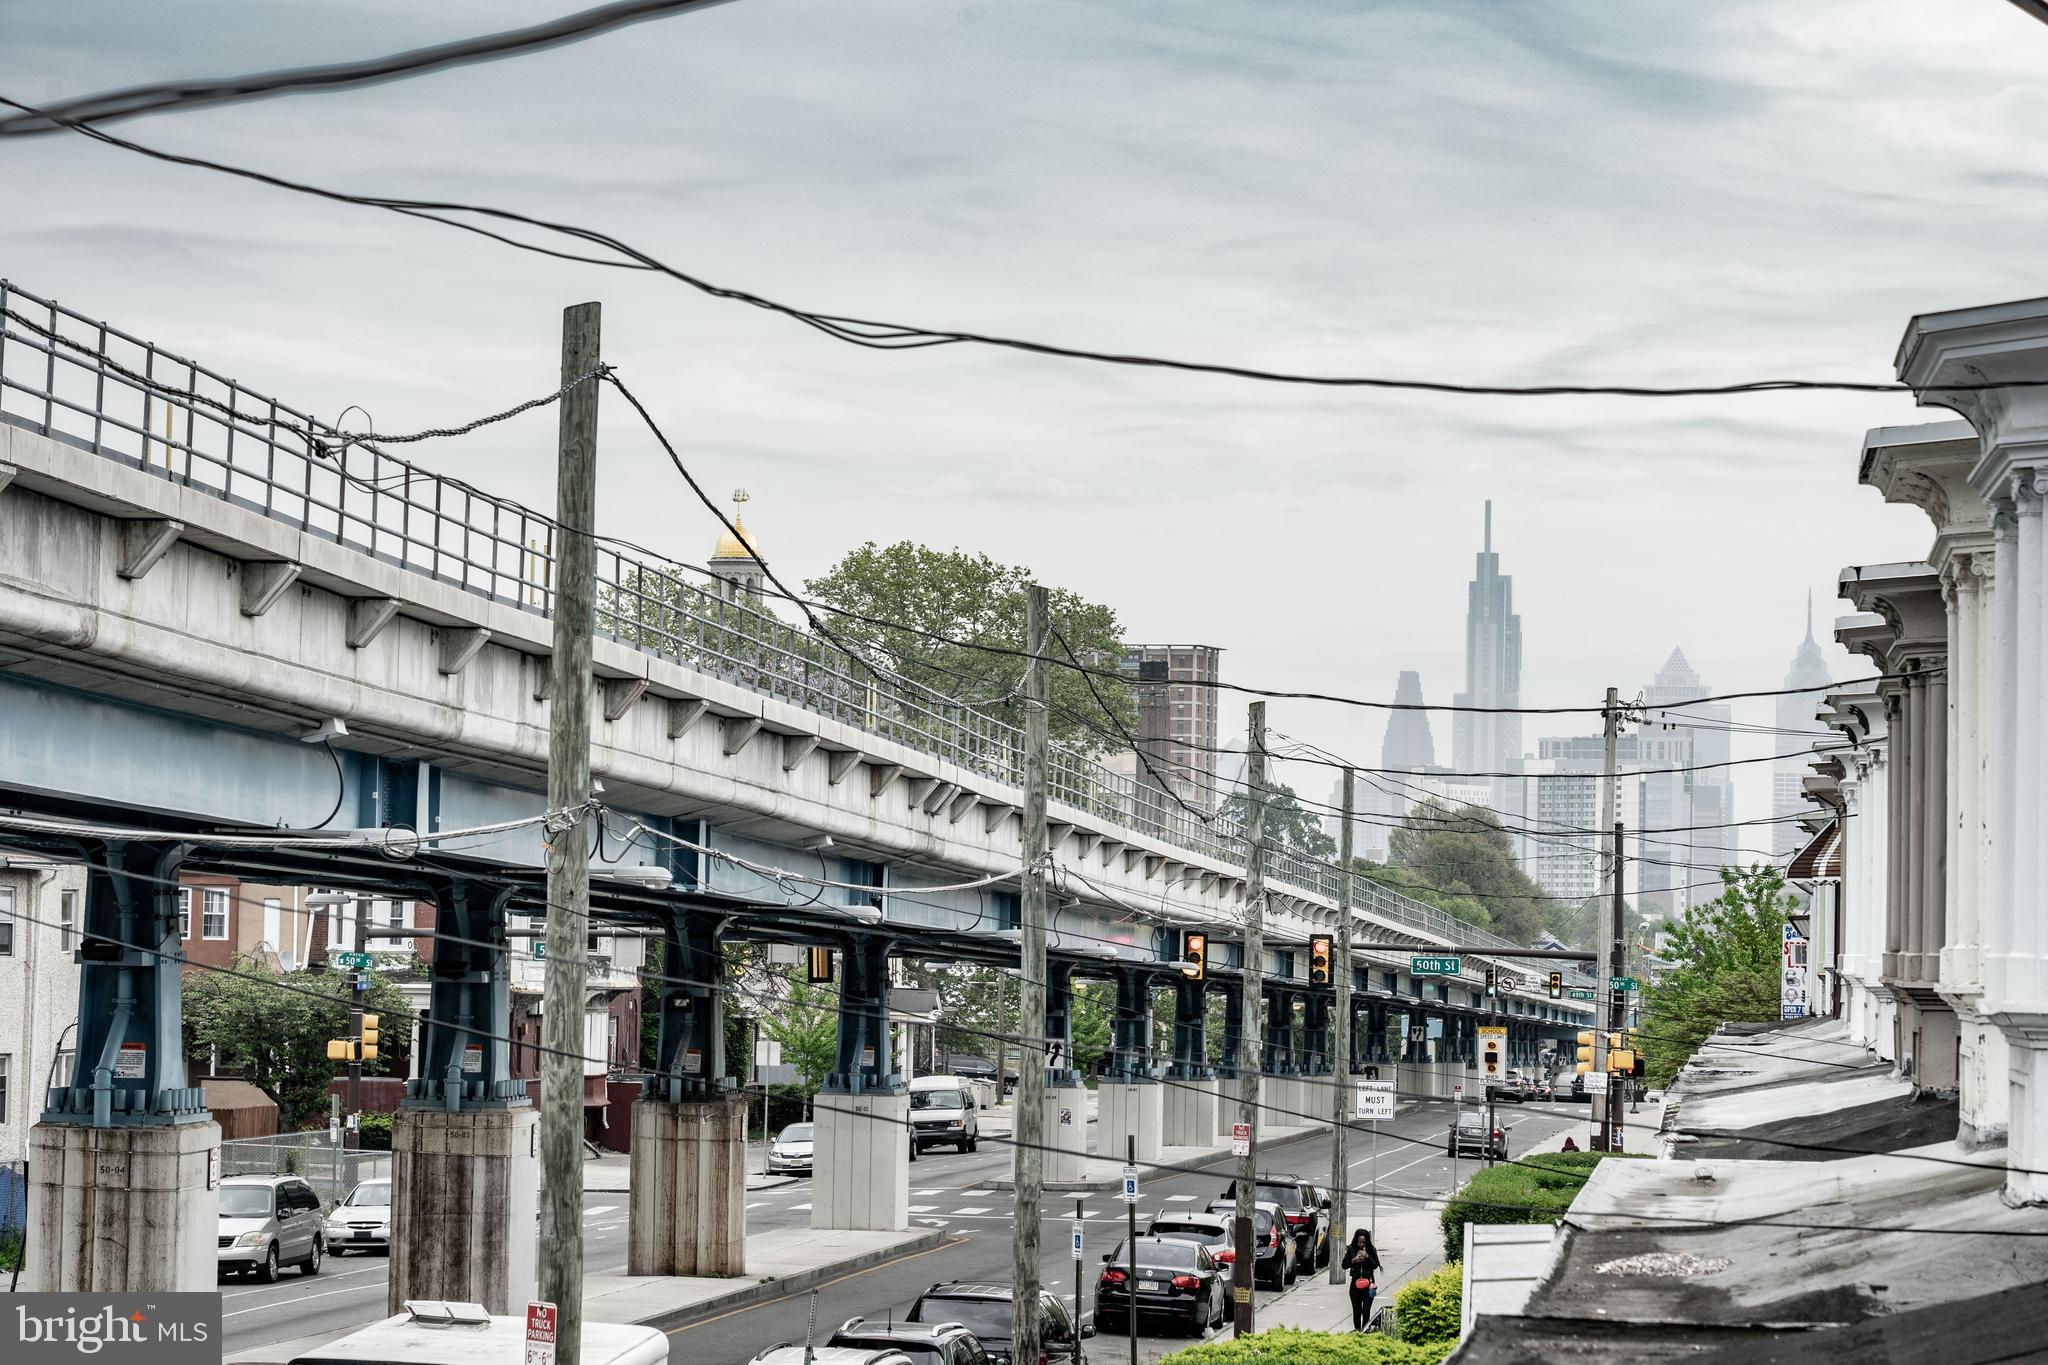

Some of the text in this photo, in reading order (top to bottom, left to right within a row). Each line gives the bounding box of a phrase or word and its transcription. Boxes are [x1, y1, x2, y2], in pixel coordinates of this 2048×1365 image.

[1416, 960, 1456, 971] 50th St
[1365, 1096, 1385, 1105] MUST
[1358, 1107, 1374, 1115] TURN
[100, 1166, 126, 1175] 50-04
[536, 1307, 547, 1319] NO
[531, 1318, 552, 1330] TRUCK
[527, 1328, 554, 1342] PARKING
